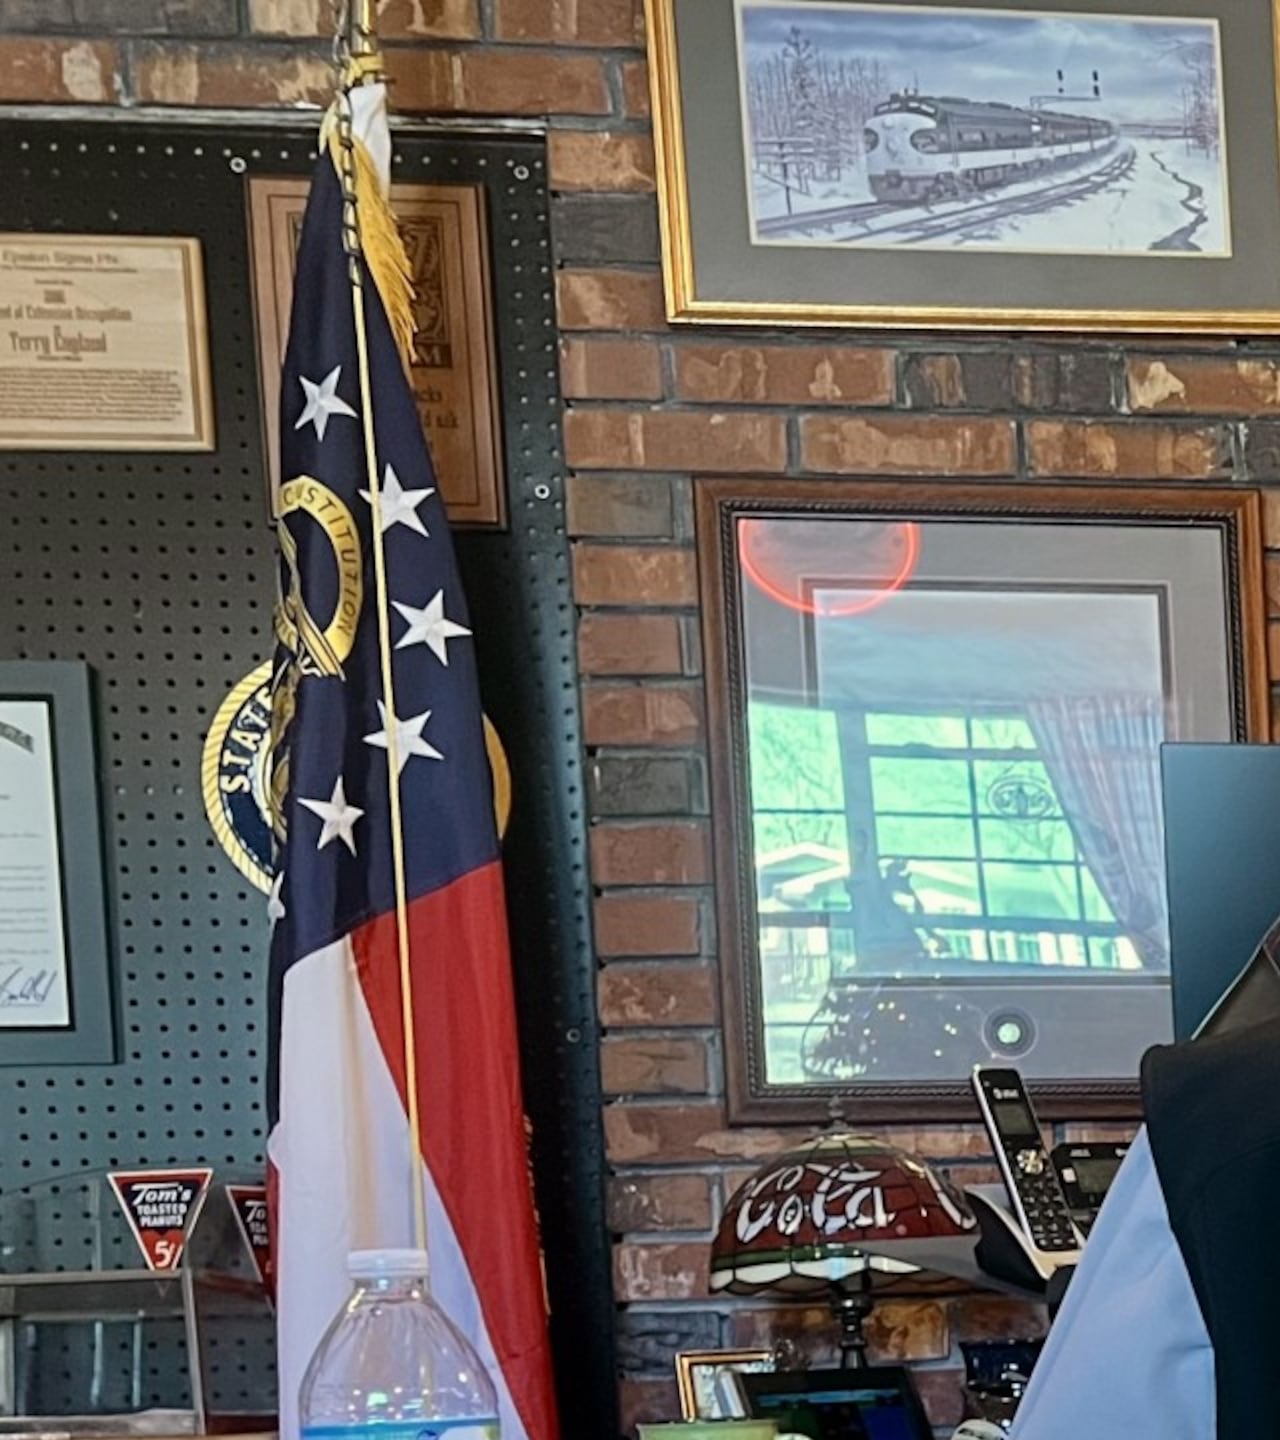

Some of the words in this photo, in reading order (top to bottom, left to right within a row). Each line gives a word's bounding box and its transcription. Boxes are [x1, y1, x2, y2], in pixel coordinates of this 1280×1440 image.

[283, 484, 358, 637] CSTITUTION
[131, 1182, 193, 1206] Tom's
[137, 1203, 187, 1215] TOASTED
[140, 1215, 183, 1227] PEANUTS
